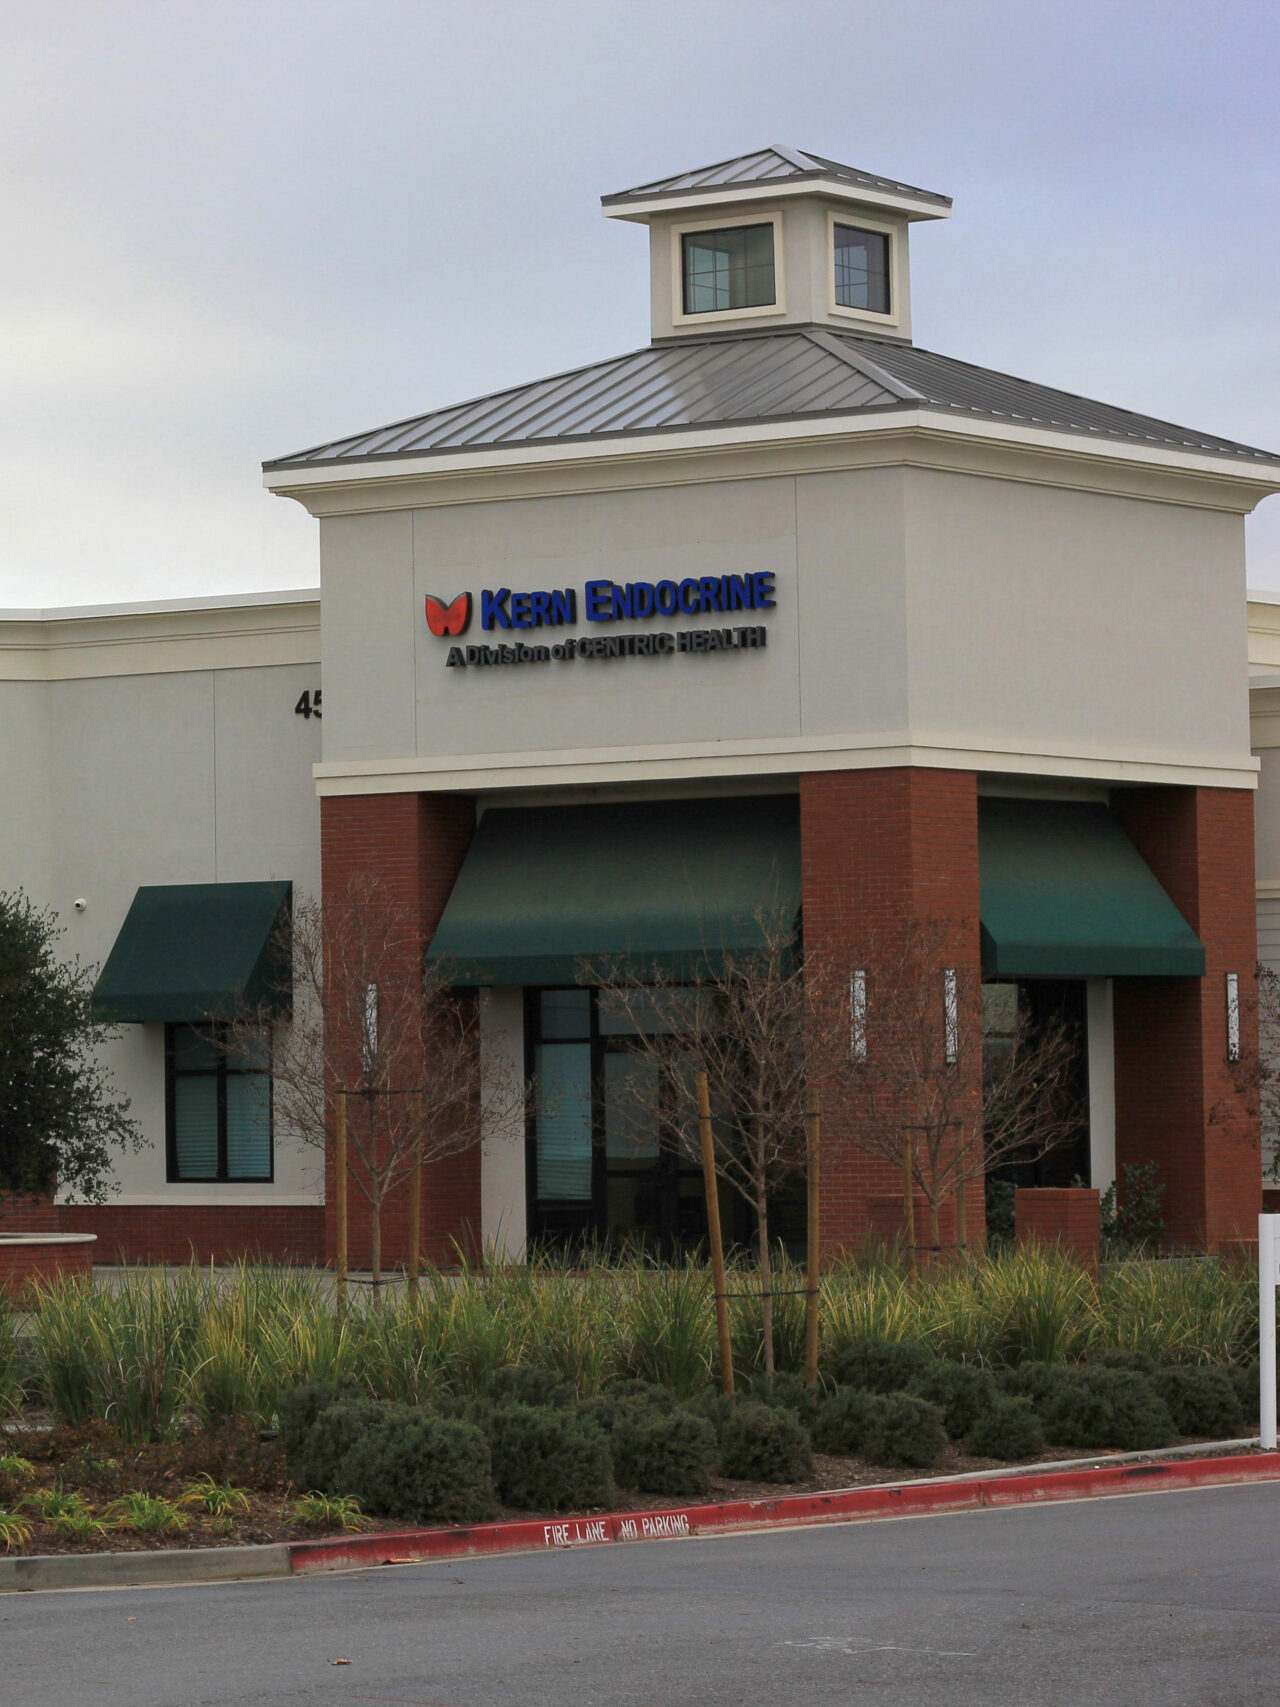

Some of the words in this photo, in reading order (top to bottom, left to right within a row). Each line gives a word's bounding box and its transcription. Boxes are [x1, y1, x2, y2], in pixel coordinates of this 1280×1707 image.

[481, 588, 576, 630] KERN
[585, 571, 776, 621] ENDOCRINE
[446, 646, 466, 667] A
[466, 642, 550, 665] Division
[551, 638, 576, 660] of
[577, 632, 675, 658] CENTRIC
[677, 626, 766, 652] HEALTH
[543, 1524, 571, 1546] FIRE
[575, 1521, 610, 1543] LANE
[621, 1519, 638, 1540] NO
[642, 1514, 690, 1537] PARKING
